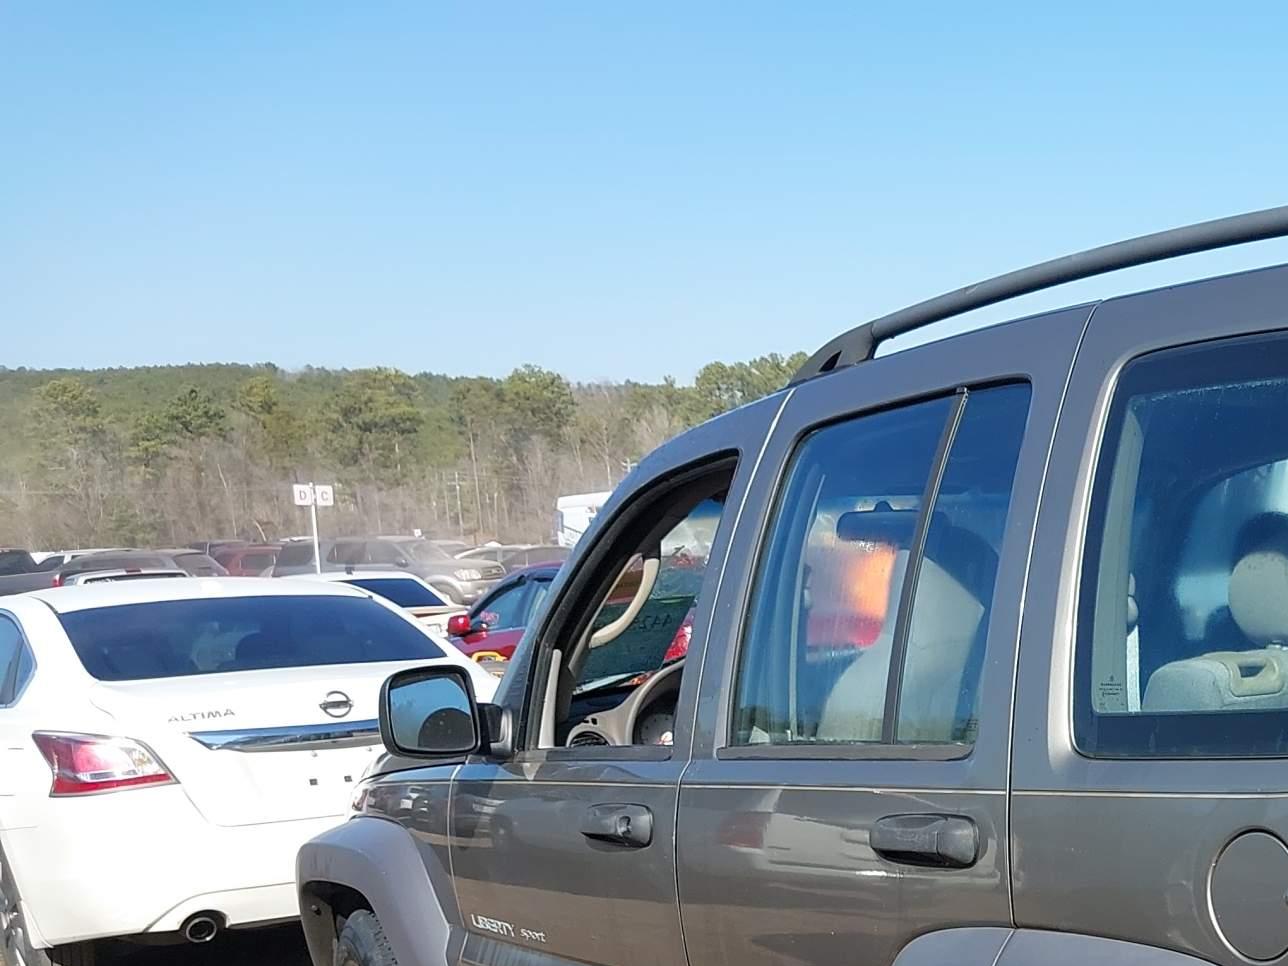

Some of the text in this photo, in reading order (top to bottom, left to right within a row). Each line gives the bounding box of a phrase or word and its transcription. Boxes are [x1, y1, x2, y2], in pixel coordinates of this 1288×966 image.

[320, 490, 329, 501] C
[167, 708, 236, 722] ALTIMA
[470, 913, 515, 937] LIBERTY
